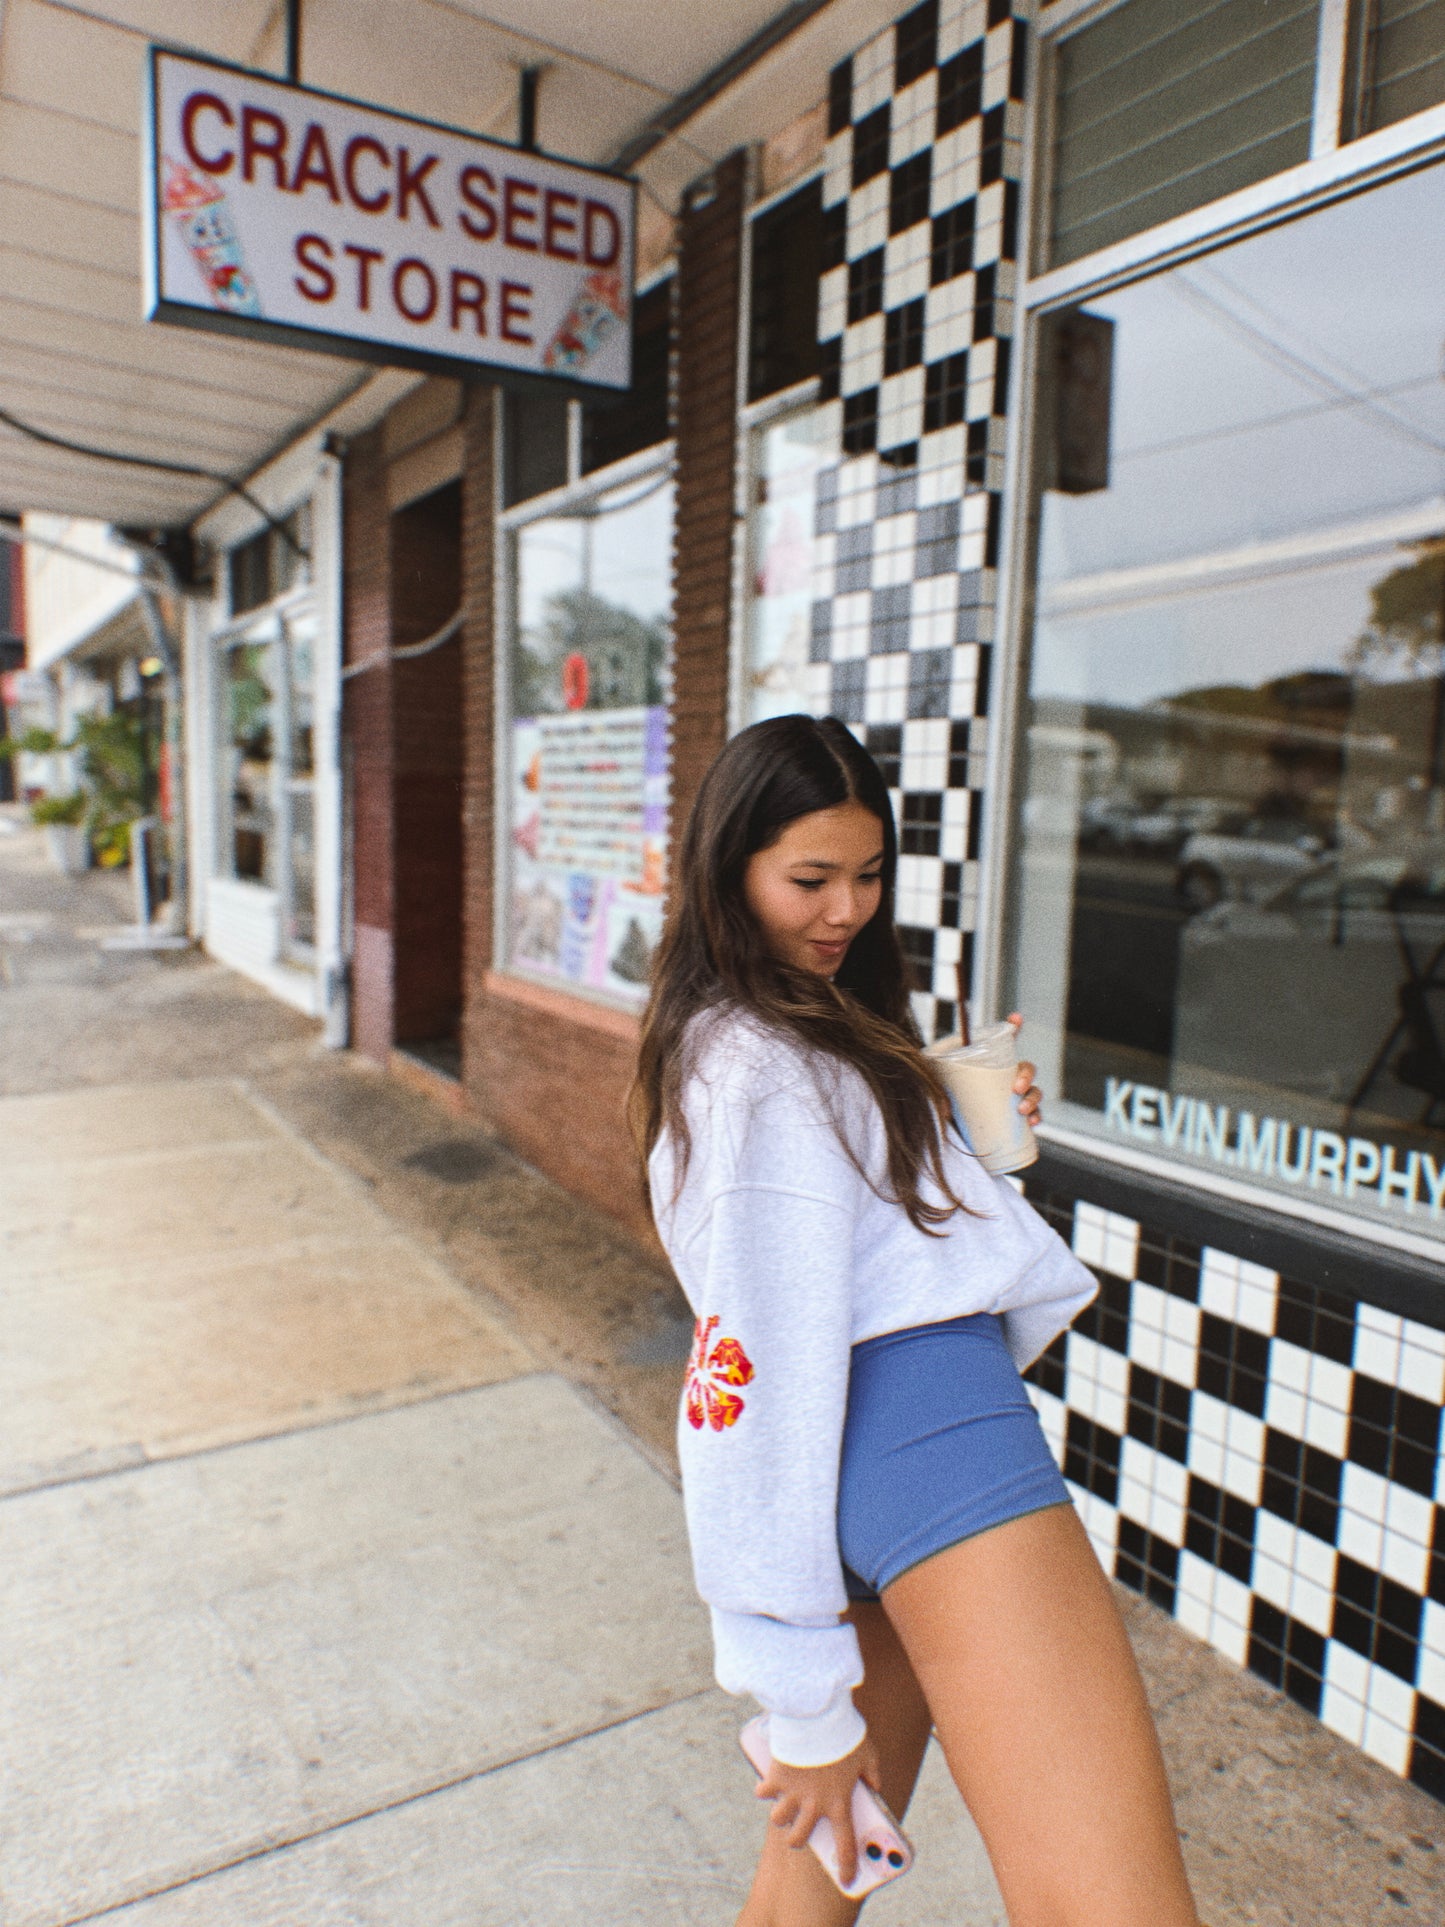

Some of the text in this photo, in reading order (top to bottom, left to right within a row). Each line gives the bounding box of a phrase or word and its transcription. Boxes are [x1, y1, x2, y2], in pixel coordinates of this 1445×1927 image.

[181, 91, 622, 269] CRACK SEED
[294, 233, 534, 346] STORE
[1105, 1076, 1445, 1220] KEVIN.MURPHY
